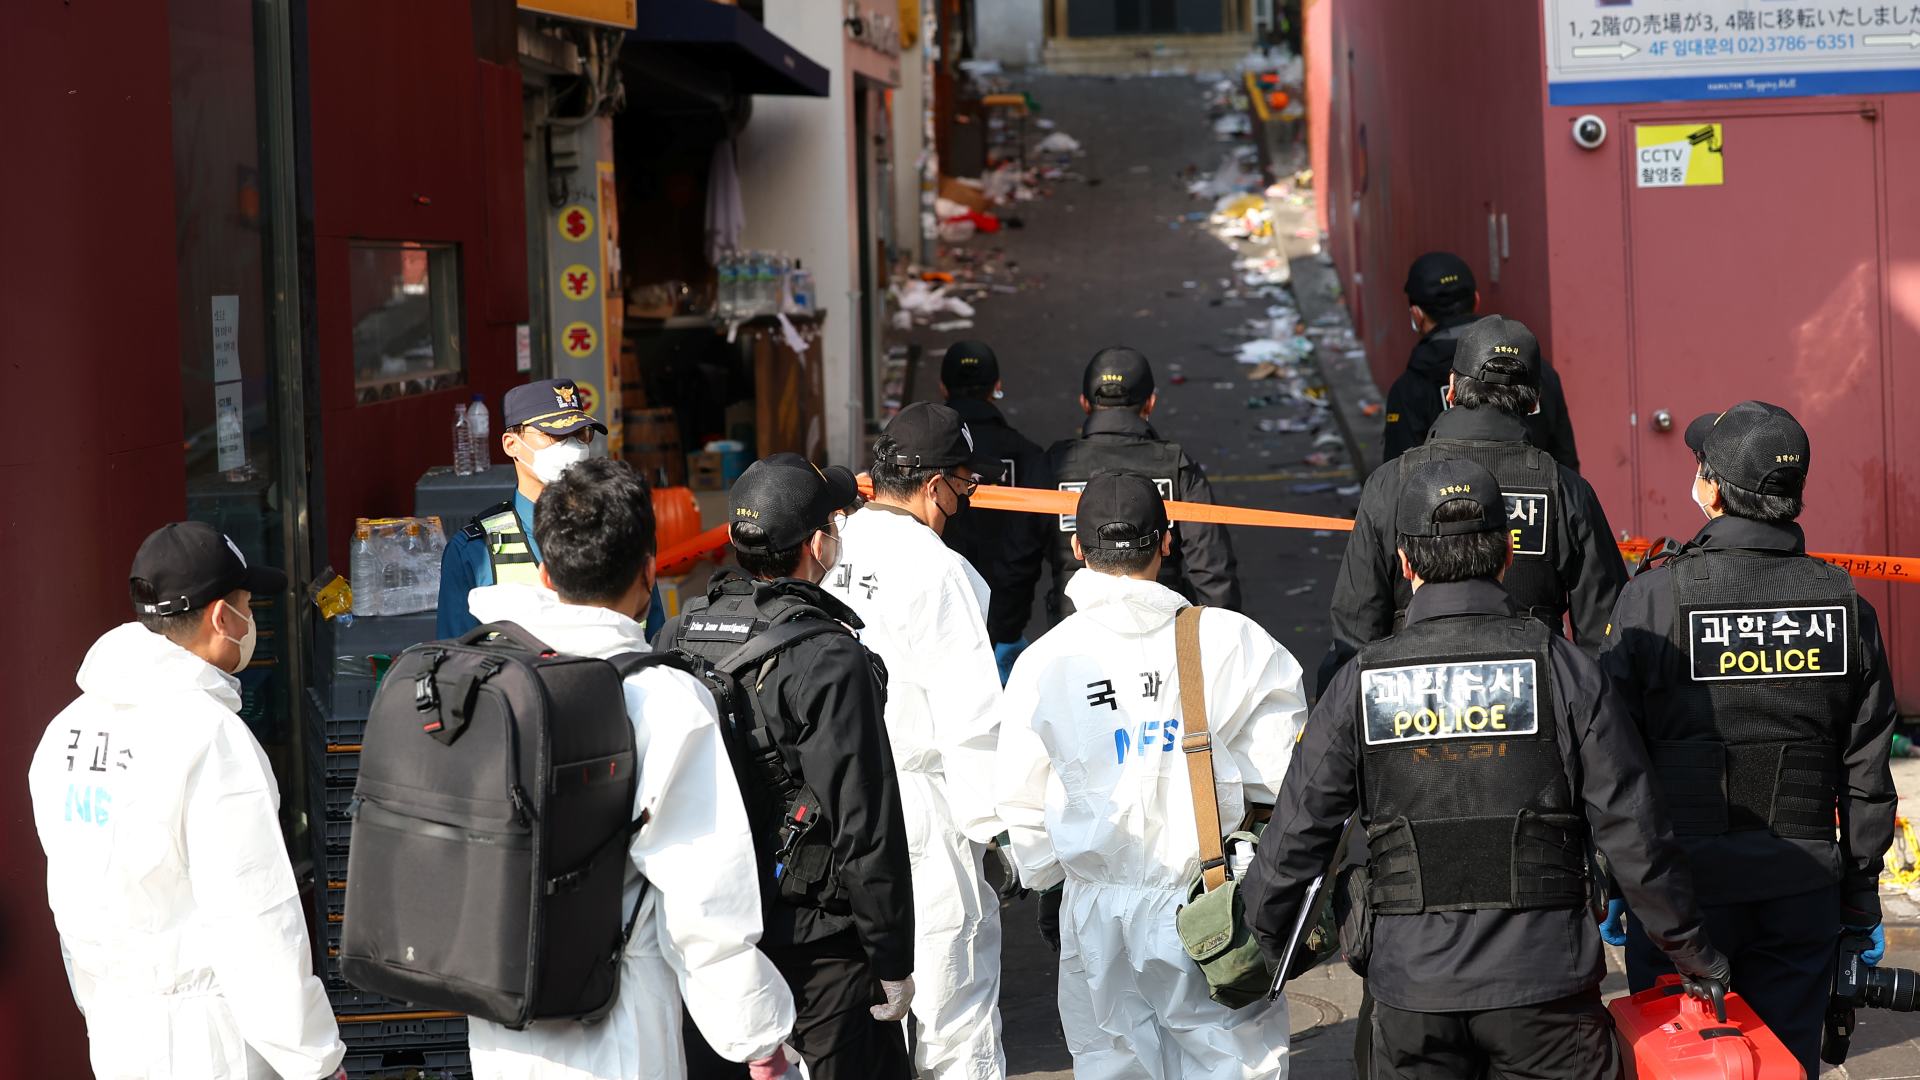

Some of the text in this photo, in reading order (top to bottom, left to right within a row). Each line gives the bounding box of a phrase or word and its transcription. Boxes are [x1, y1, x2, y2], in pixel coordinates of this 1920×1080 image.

[1648, 33, 1855, 57] 4F 임대문의 02)3786-6351
[1641, 149, 1683, 163] CCTV
[1642, 166, 1682, 183] 촬영중
[566, 209, 586, 238] $
[567, 272, 588, 296] ¥
[569, 328, 591, 351] 元
[1440, 485, 1471, 496] 과학수사
[1701, 613, 1836, 646] 과학수사
[1720, 648, 1820, 674] POLICE
[1374, 667, 1524, 705] 과학수사
[1394, 705, 1506, 736] POLICE
[1114, 718, 1179, 765] NFS
